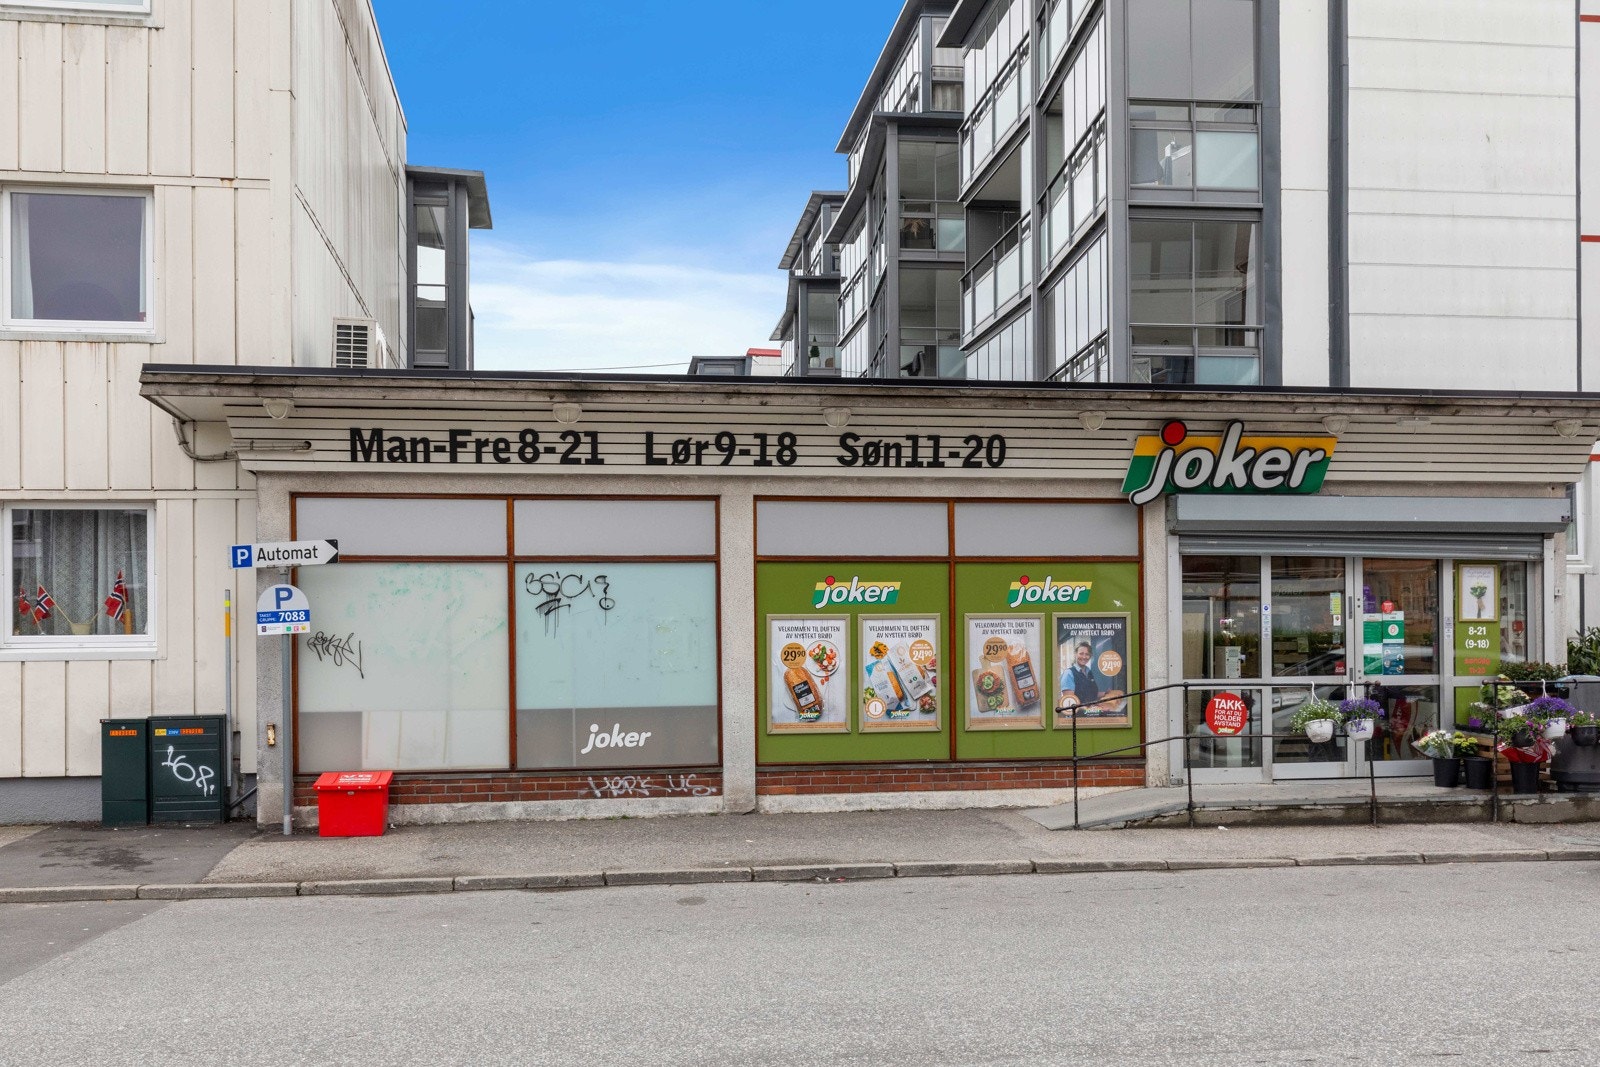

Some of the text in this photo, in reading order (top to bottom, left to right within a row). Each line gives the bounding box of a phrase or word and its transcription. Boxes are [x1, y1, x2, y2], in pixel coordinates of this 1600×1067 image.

[1129, 419, 1327, 506] joker
[236, 545, 318, 565] P Automat
[275, 587, 293, 610] P
[815, 575, 895, 609] joker
[1010, 575, 1086, 608] joker
[278, 611, 306, 622] 7088
[1468, 626, 1487, 635] 8-21
[1465, 639, 1490, 649] (9-18)
[1213, 720, 1241, 728] AVSTAND
[1214, 714, 1242, 722] HOLDER
[580, 723, 652, 755] joker
